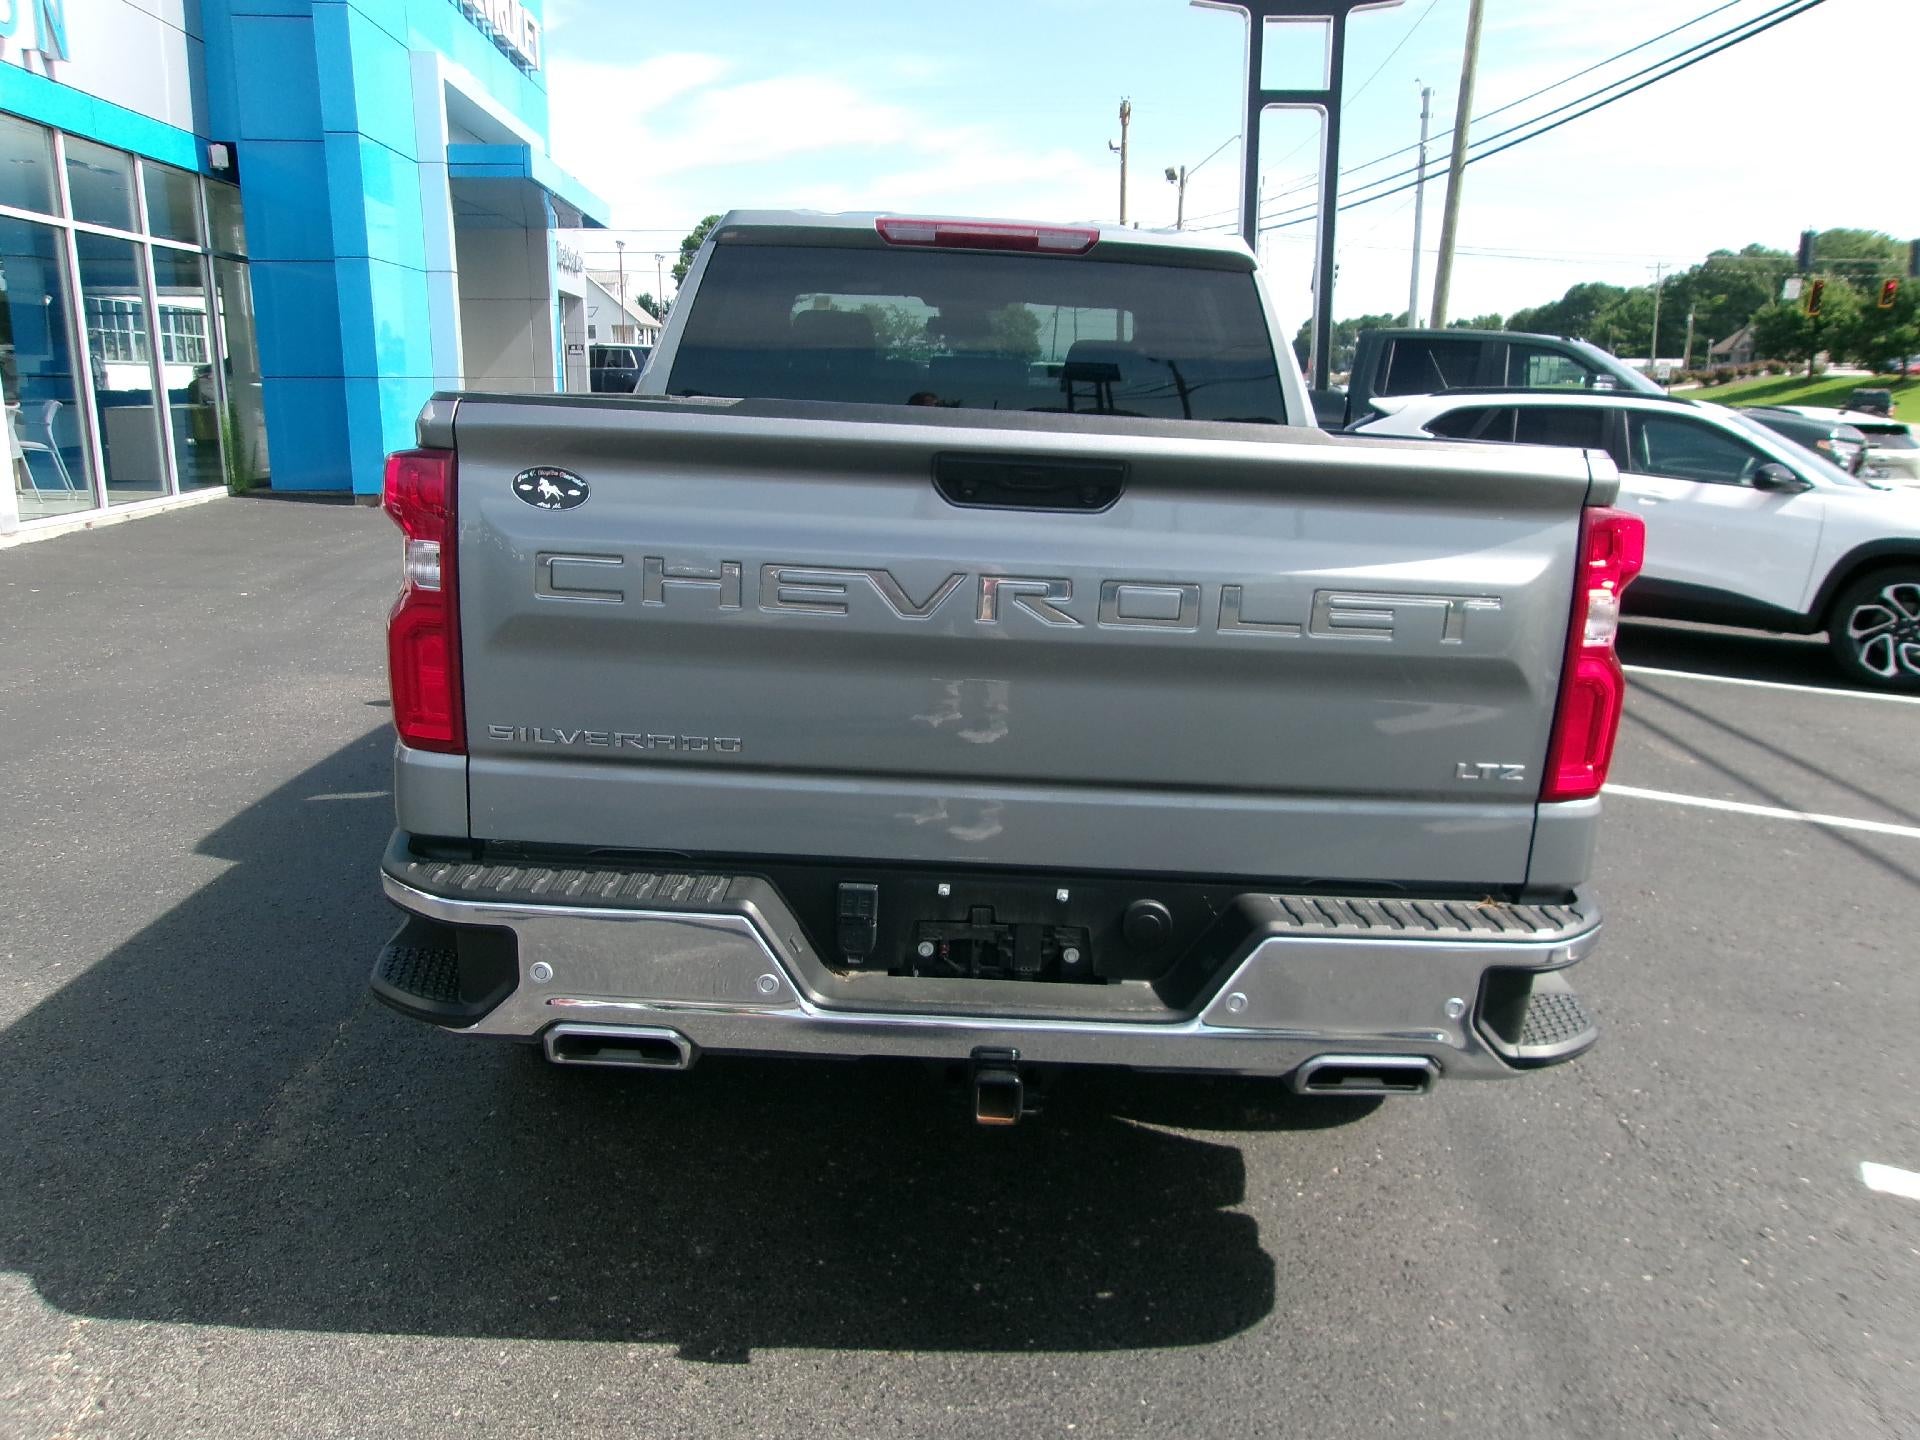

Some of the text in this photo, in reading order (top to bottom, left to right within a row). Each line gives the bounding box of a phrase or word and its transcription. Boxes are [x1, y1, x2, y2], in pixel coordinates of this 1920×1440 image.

[535, 551, 1502, 646] CHEVROLET
[487, 723, 743, 752] SILVERADO
[1456, 762, 1526, 780] LTZ
